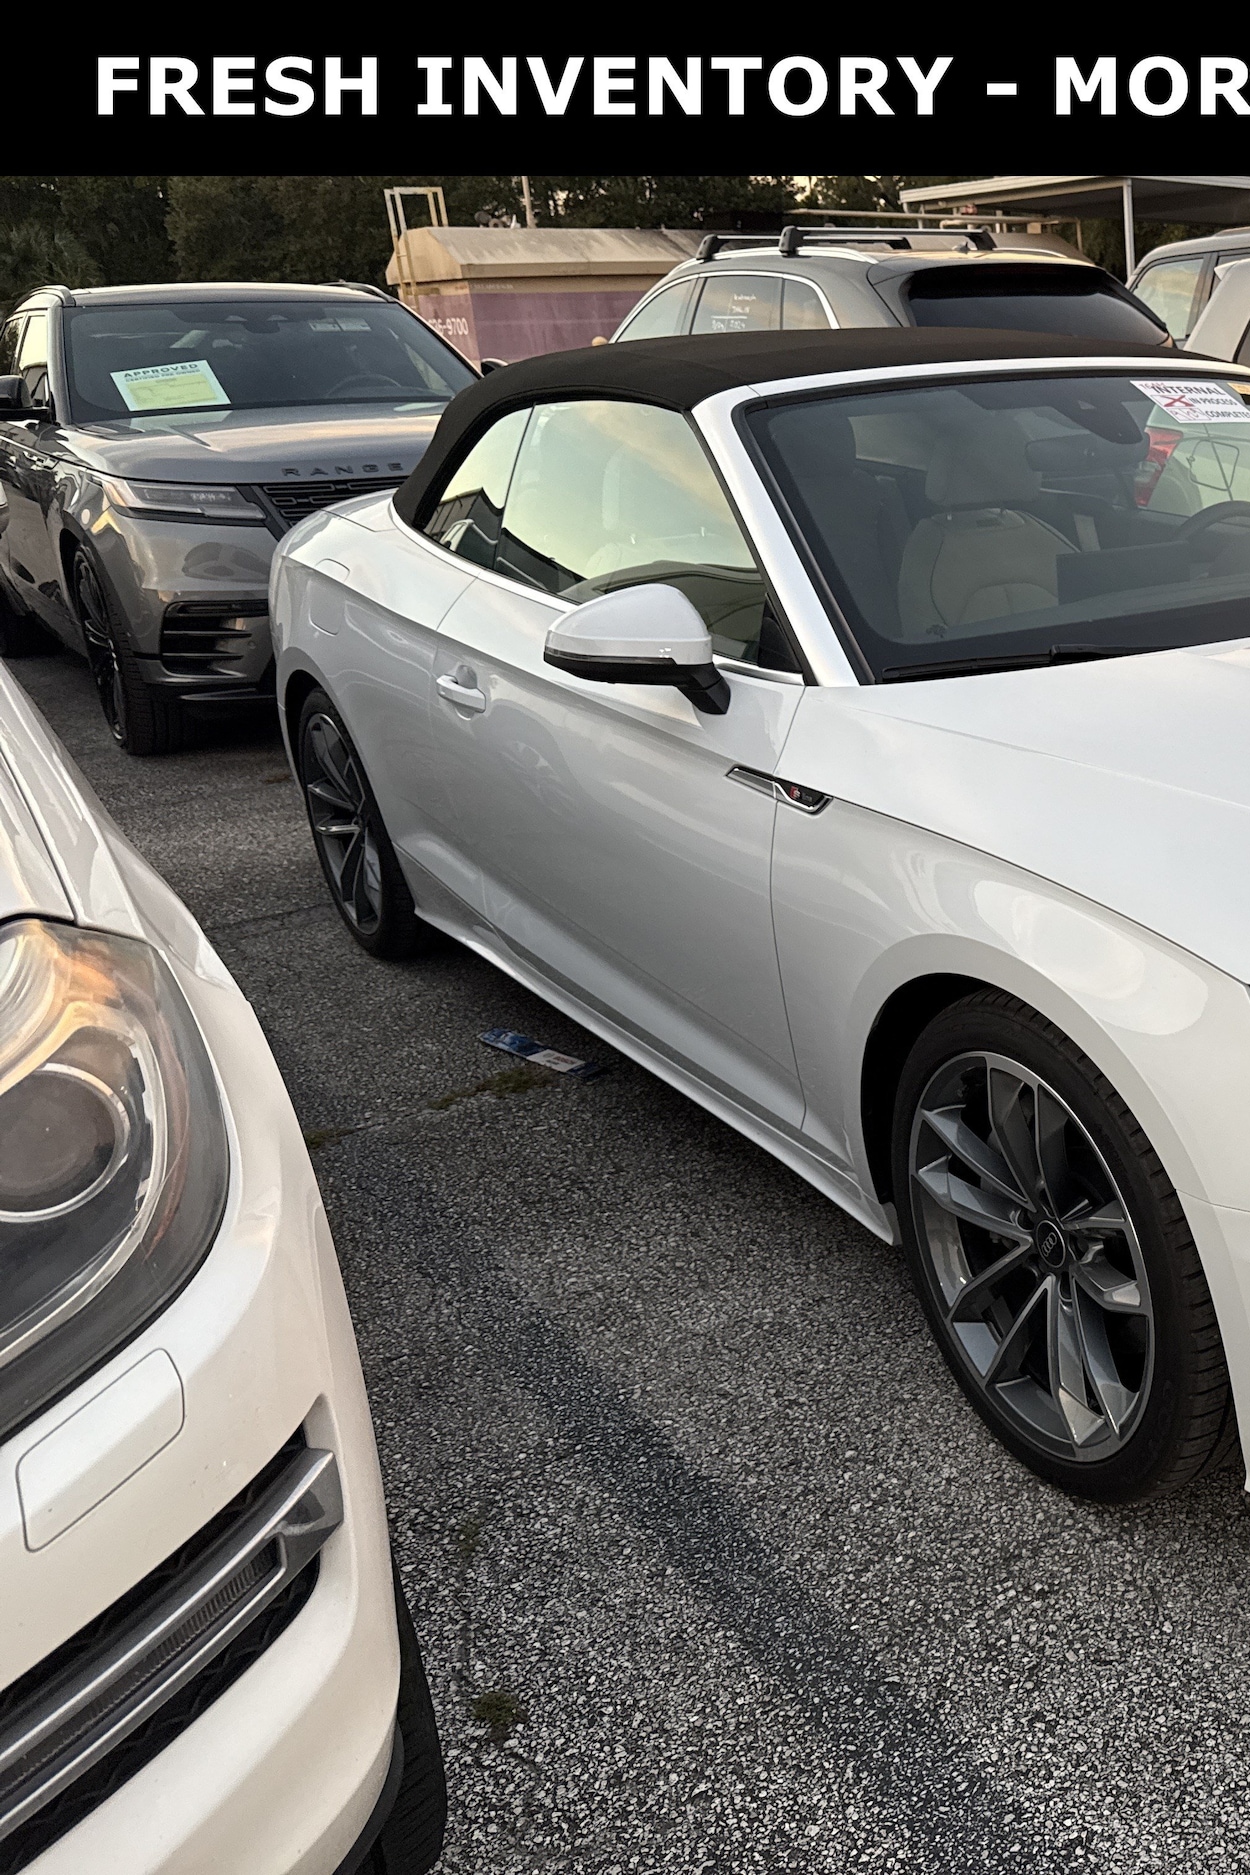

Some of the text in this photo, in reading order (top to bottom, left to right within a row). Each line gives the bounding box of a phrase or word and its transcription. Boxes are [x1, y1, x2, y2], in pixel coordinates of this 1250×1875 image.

[124, 363, 198, 377] APPROVED
[1151, 386, 1226, 396] INTERNAL
[1202, 397, 1238, 406] PROCESS
[281, 462, 404, 477] RANGE
